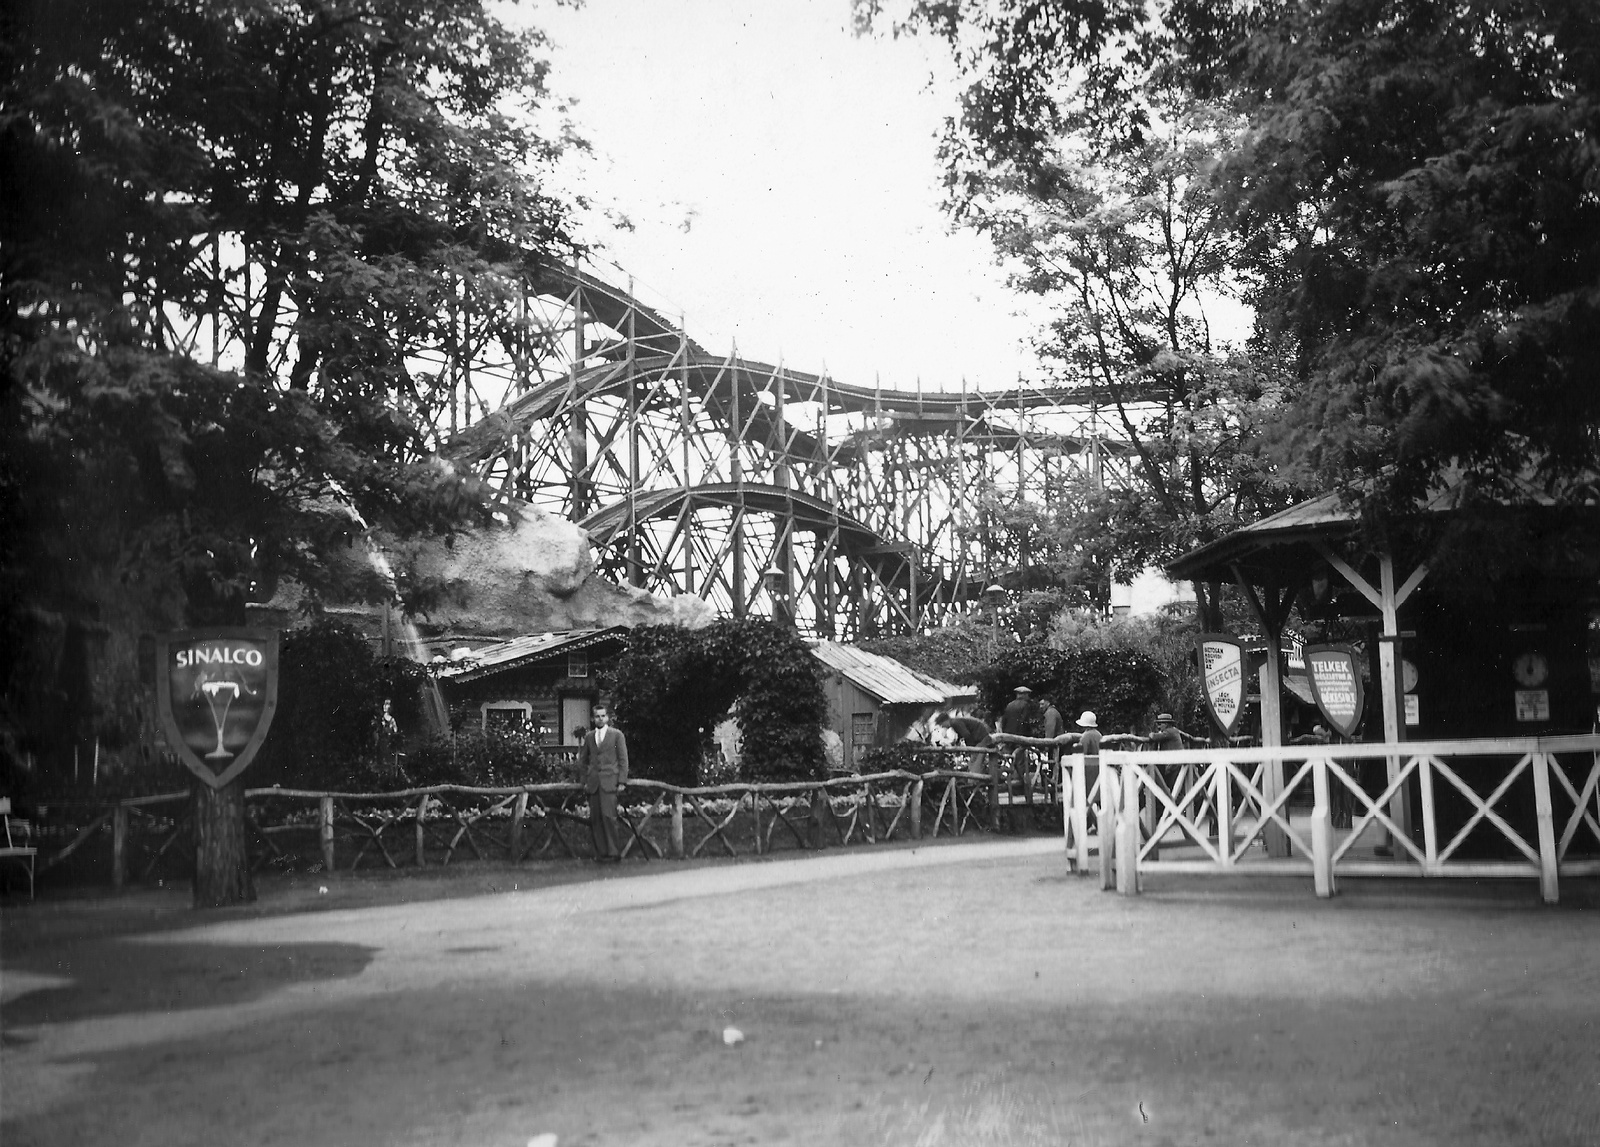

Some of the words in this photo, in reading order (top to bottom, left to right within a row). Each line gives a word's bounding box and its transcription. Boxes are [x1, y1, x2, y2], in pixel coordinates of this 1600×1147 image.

[176, 647, 262, 668] SINALCO
[1312, 661, 1349, 672] TELKEK
[1207, 666, 1240, 689] INSECTA
